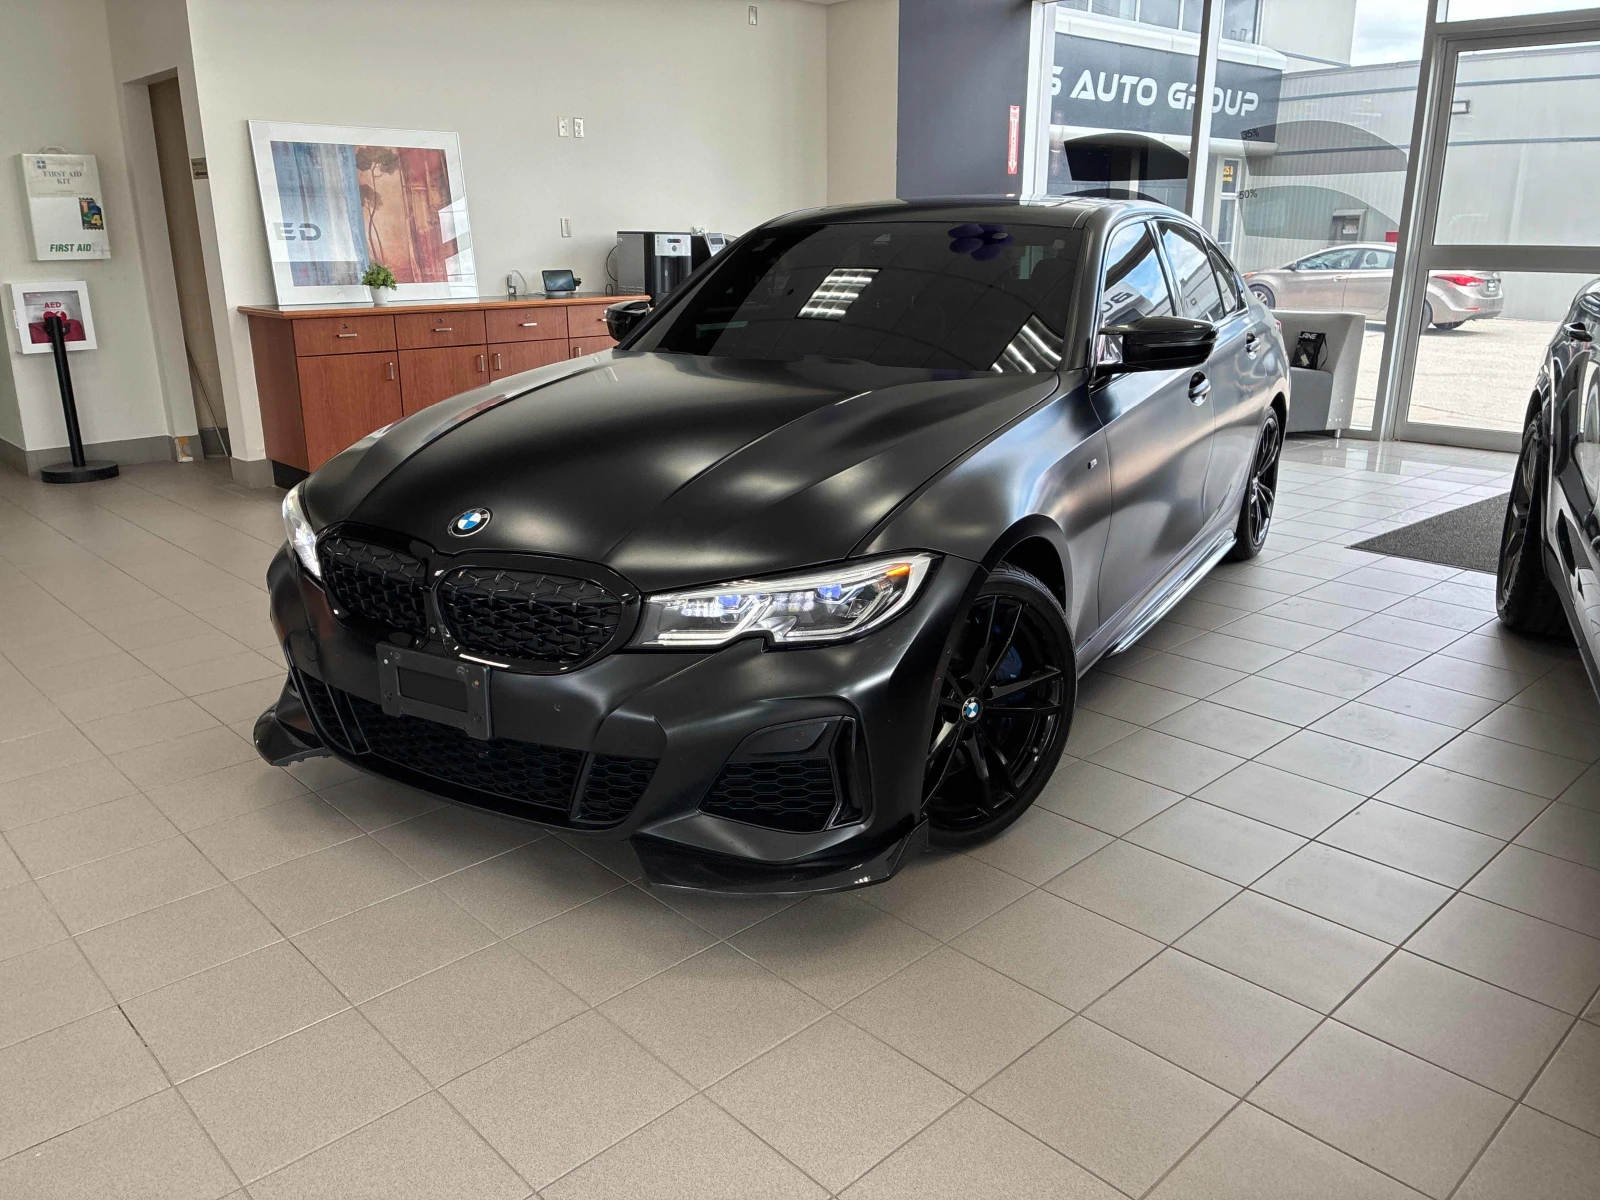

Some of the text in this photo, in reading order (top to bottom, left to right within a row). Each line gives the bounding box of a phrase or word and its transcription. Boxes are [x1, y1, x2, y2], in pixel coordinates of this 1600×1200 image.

[1069, 69, 1158, 106] AUTO
[1242, 128, 1260, 140] 35%
[1240, 189, 1258, 200] 50%
[273, 222, 321, 241] ED
[50, 244, 92, 253] FIRST AID
